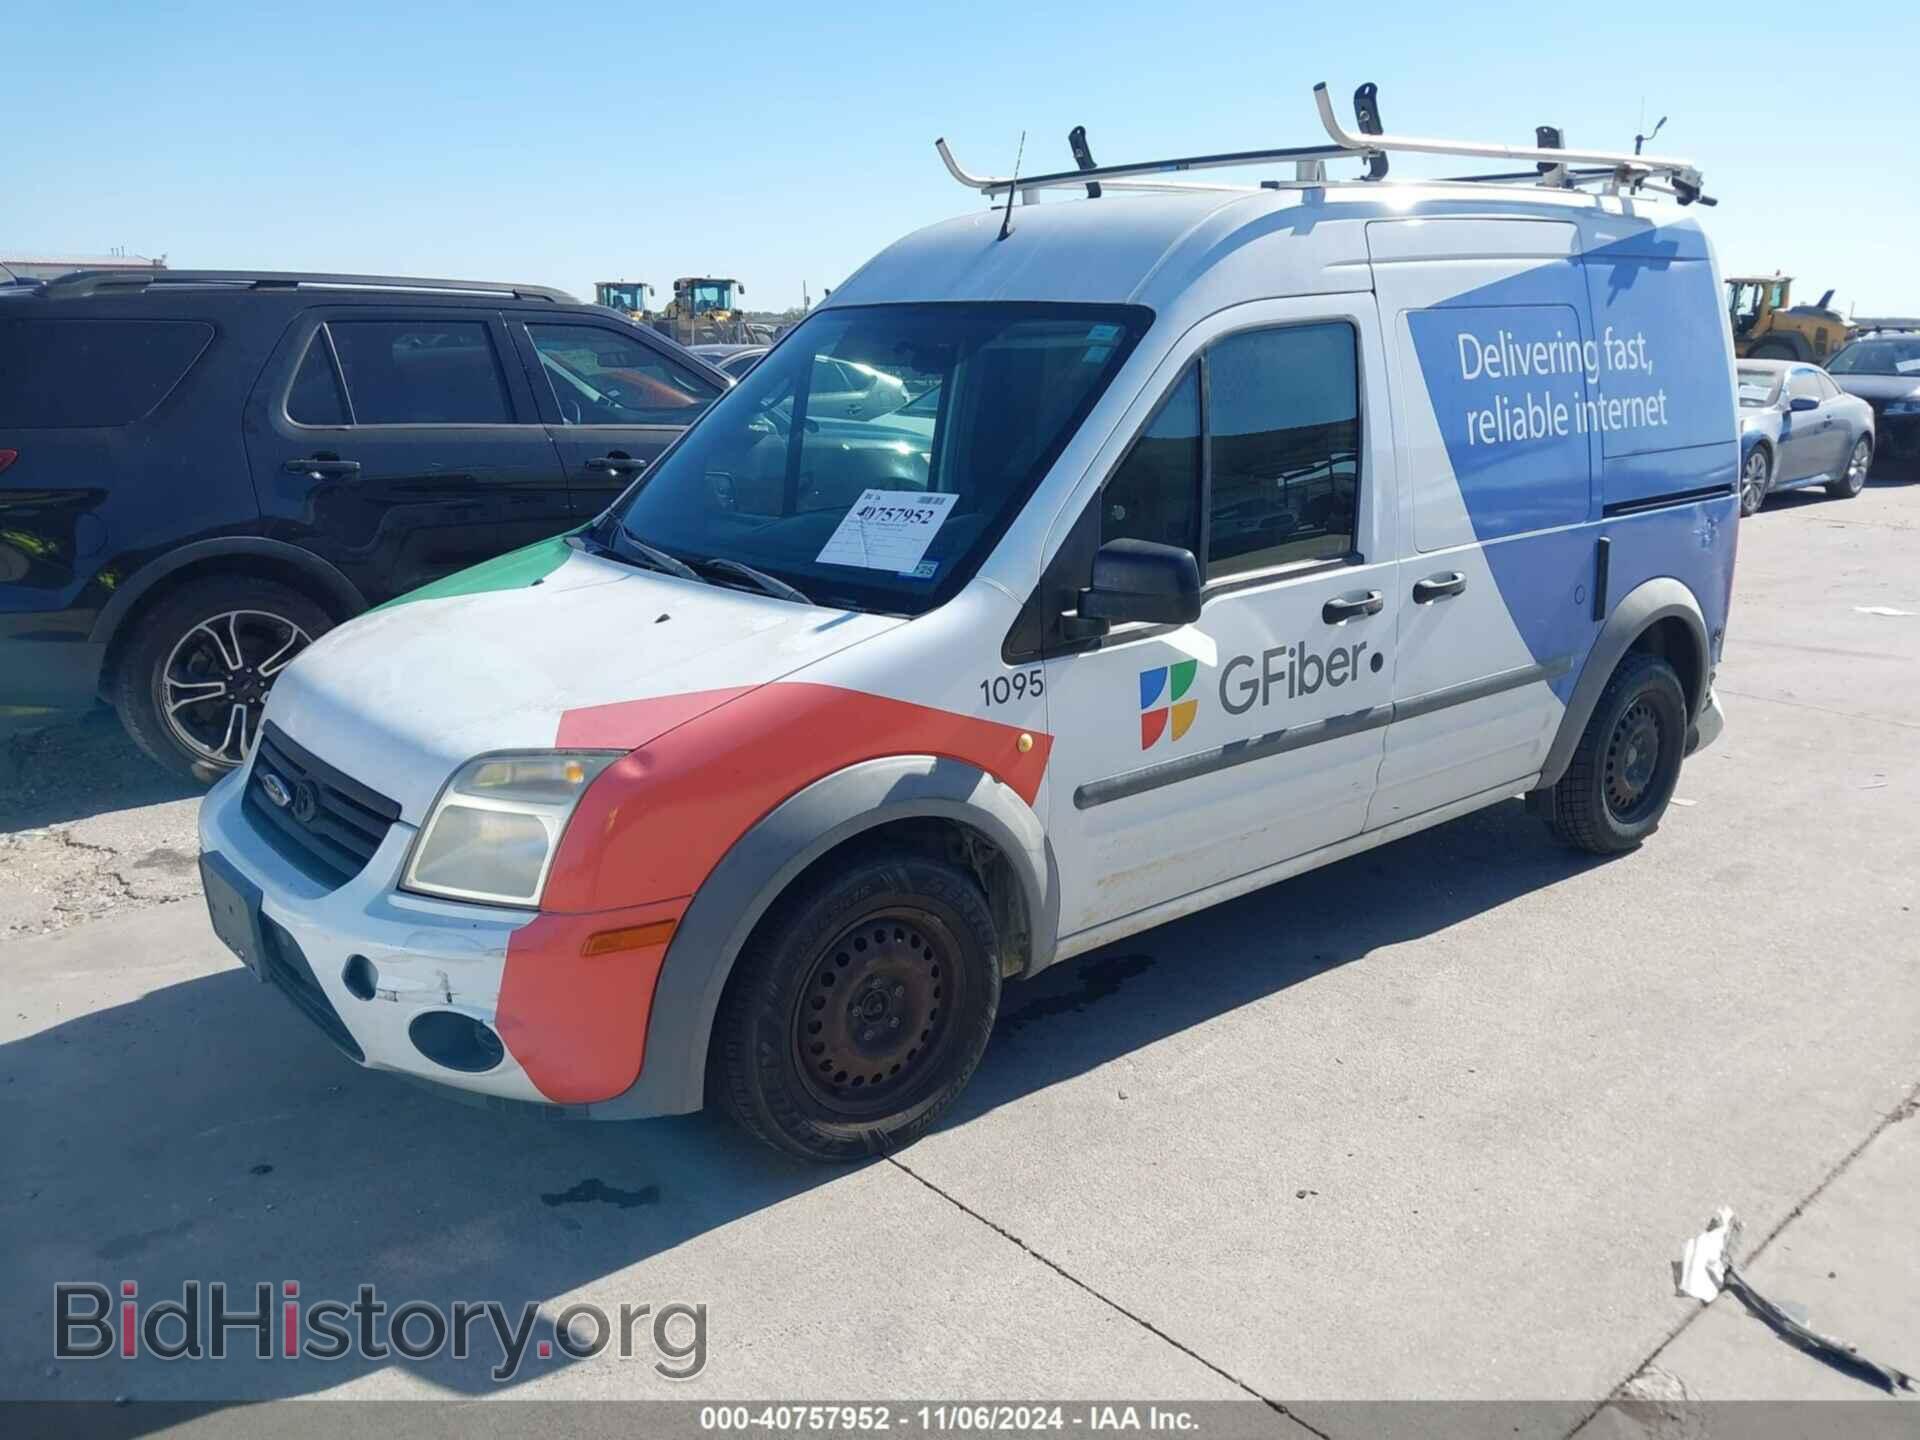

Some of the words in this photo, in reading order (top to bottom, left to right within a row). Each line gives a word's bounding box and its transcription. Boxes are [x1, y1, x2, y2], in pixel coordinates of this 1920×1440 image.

[1457, 330, 1600, 384] Delivering
[1603, 326, 1653, 376] fast,
[1466, 391, 1568, 445] reliable
[1574, 388, 1668, 433] internet
[980, 669, 1045, 707] 1095
[1218, 640, 1368, 716] GFiber
